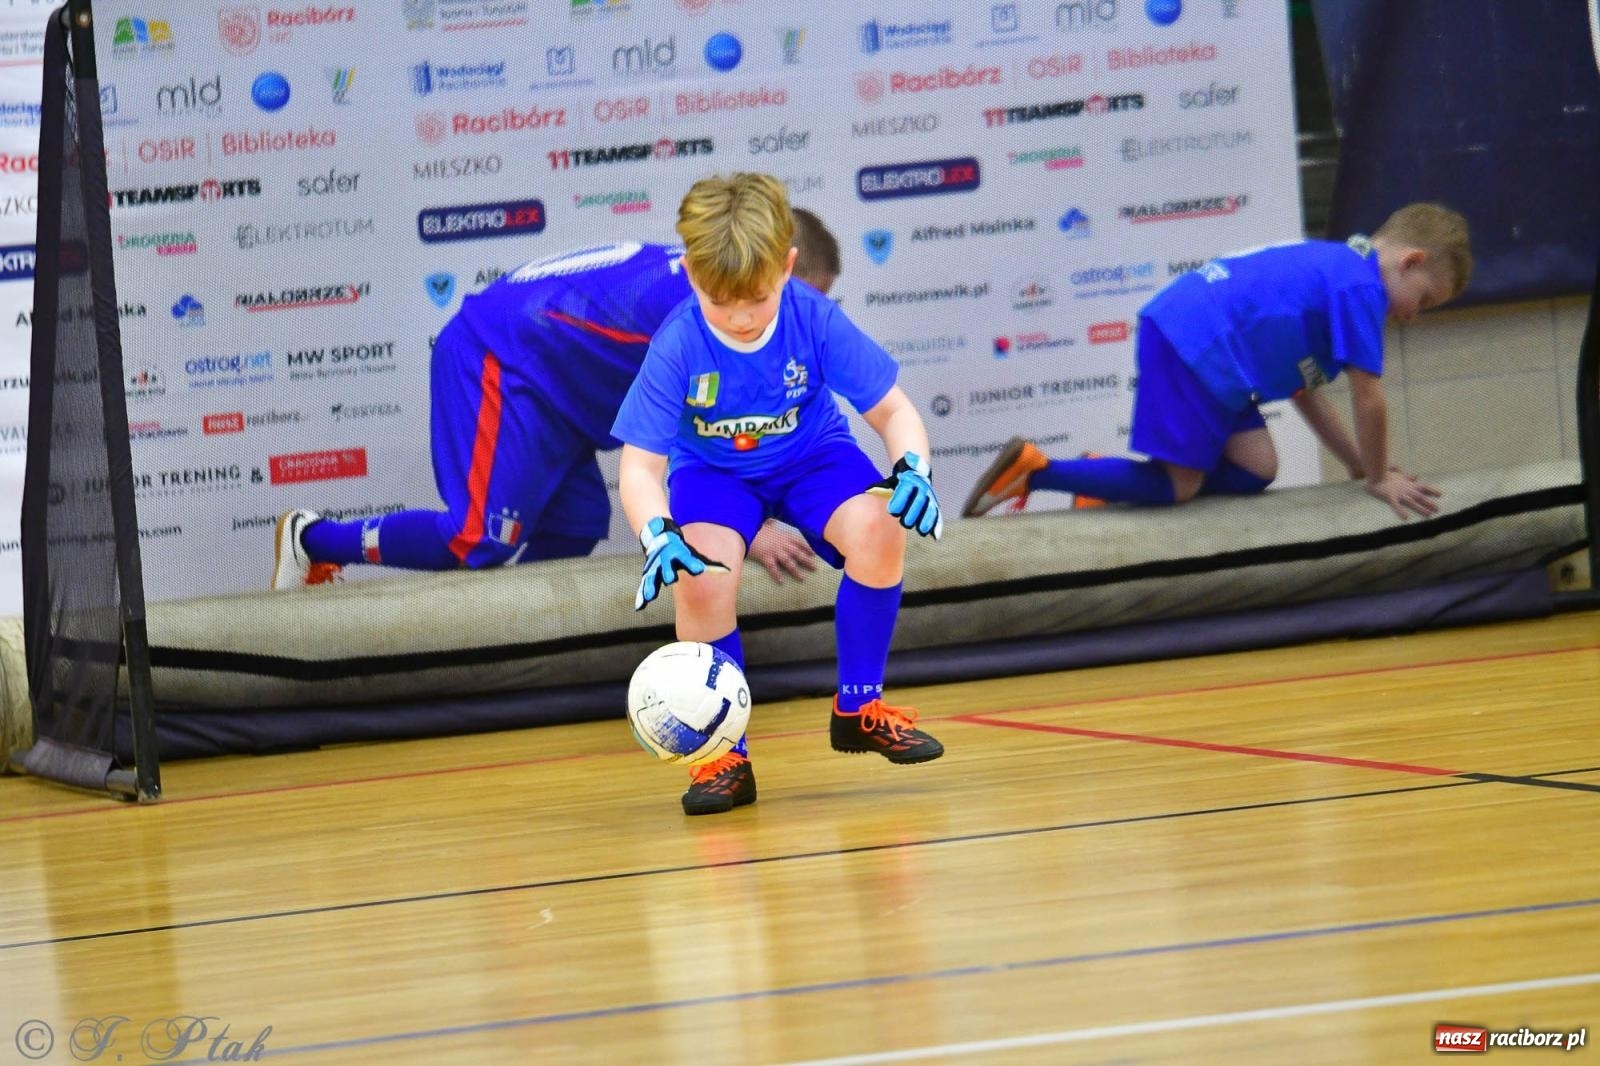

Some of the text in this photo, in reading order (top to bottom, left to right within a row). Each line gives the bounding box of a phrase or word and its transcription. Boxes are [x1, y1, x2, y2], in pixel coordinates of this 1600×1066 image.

[612, 36, 676, 72] mld
[890, 62, 1002, 93] Racibórz
[1107, 41, 1217, 71] Biblioteka
[157, 75, 223, 110] mld
[1178, 82, 1240, 109] safer
[452, 105, 567, 135] Racibórz
[675, 86, 789, 116] Biblioteka
[851, 113, 939, 138] MIESZKO
[138, 137, 196, 163] OSiR
[221, 127, 336, 156] Biblioteka
[748, 126, 811, 155] safer
[413, 154, 502, 179] MIESZKO
[106, 178, 261, 209] 1TEAMSPORTS
[297, 168, 361, 197] safer
[911, 224, 966, 243] Alfred
[287, 341, 395, 366] MW SPORT
[967, 387, 1033, 407] JUNIOR
[1038, 374, 1119, 396] TRENING
[158, 465, 241, 486] TRENING
[250, 467, 264, 484] &
